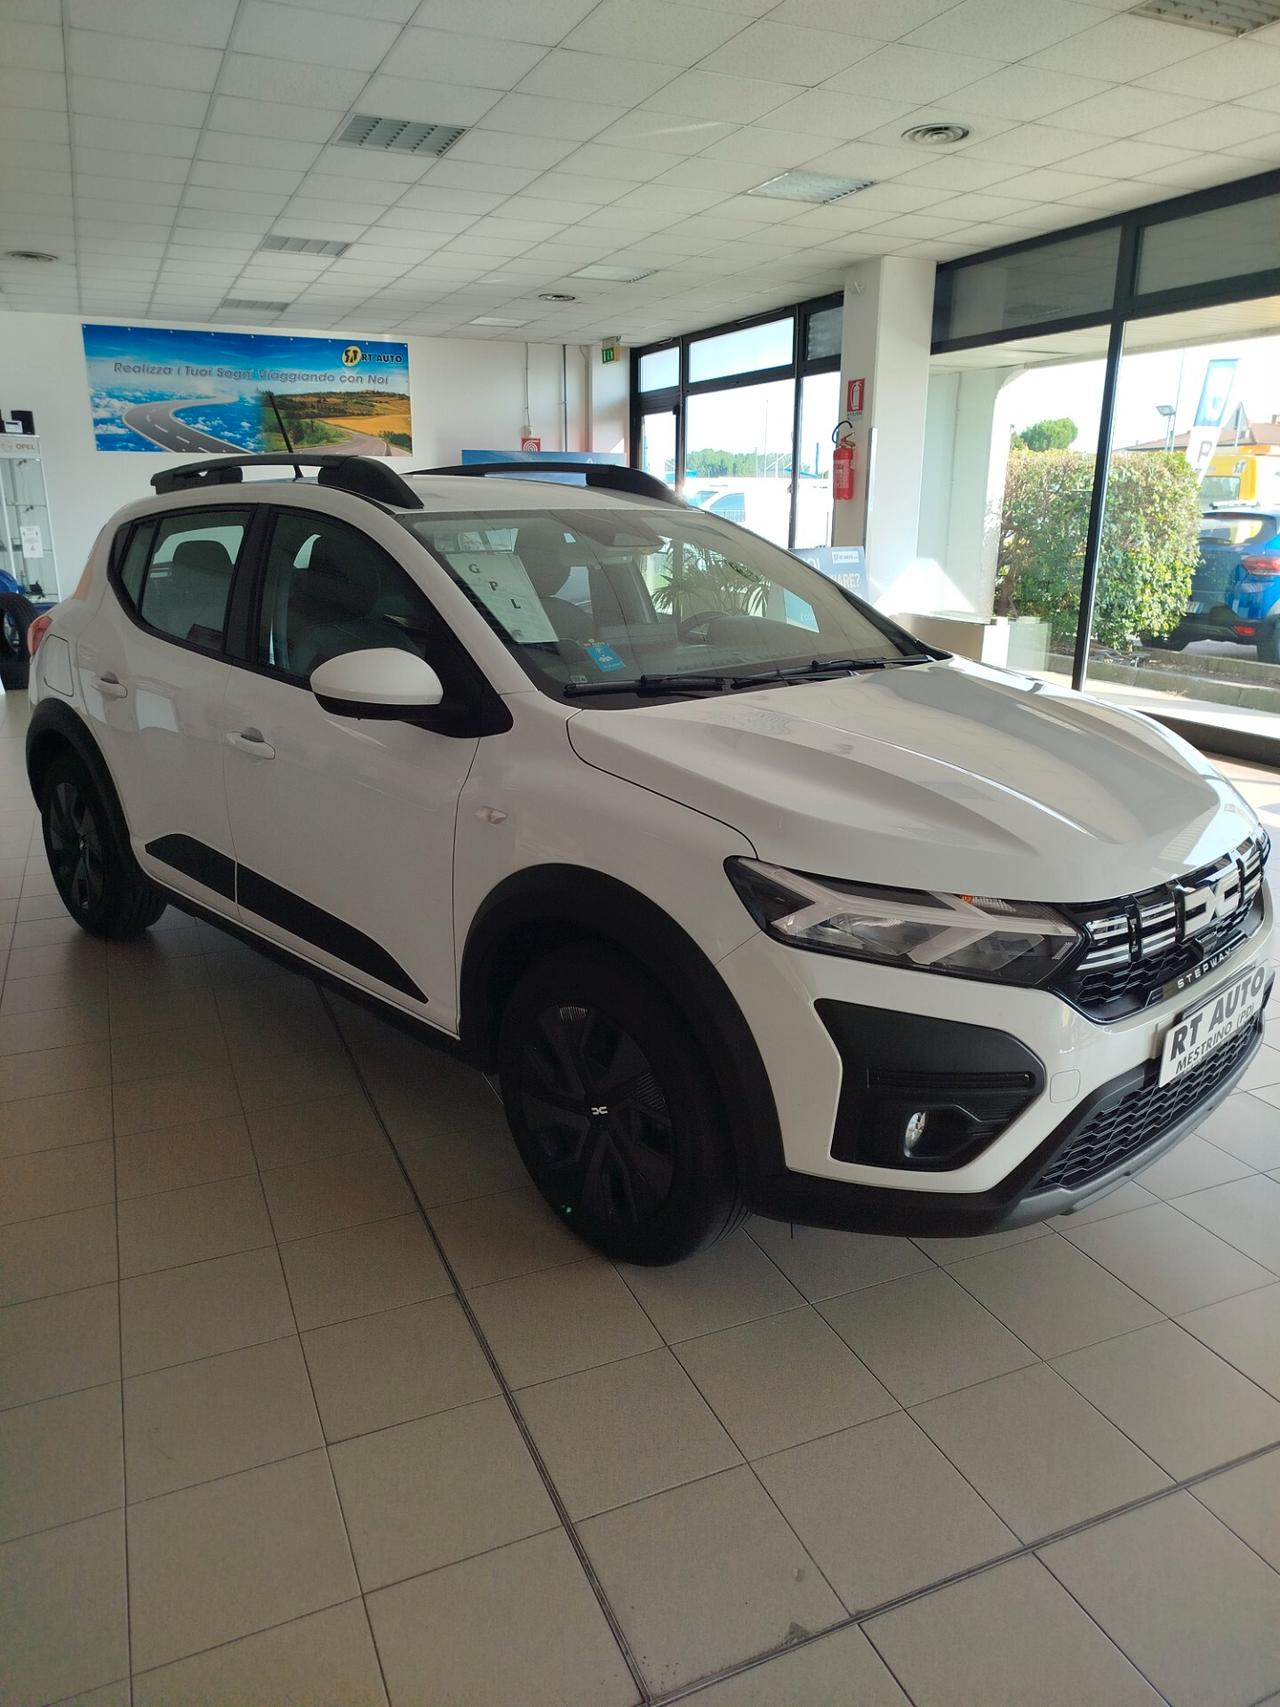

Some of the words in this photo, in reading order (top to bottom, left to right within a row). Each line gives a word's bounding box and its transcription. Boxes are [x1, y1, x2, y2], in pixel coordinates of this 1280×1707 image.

[113, 362, 173, 376] Realizza
[185, 365, 212, 377] Tuoi
[258, 368, 335, 384] Viaggiando
[339, 374, 363, 383] con
[367, 374, 389, 385] Noi
[360, 353, 373, 362] RT
[376, 354, 402, 363] AUTO
[1177, 947, 1232, 989] STEPWAY
[1170, 1012, 1203, 1061] RT
[1208, 966, 1265, 1033] AUTO
[1176, 1021, 1233, 1074] MESTRINO
[1237, 1002, 1255, 1028] (PD)
